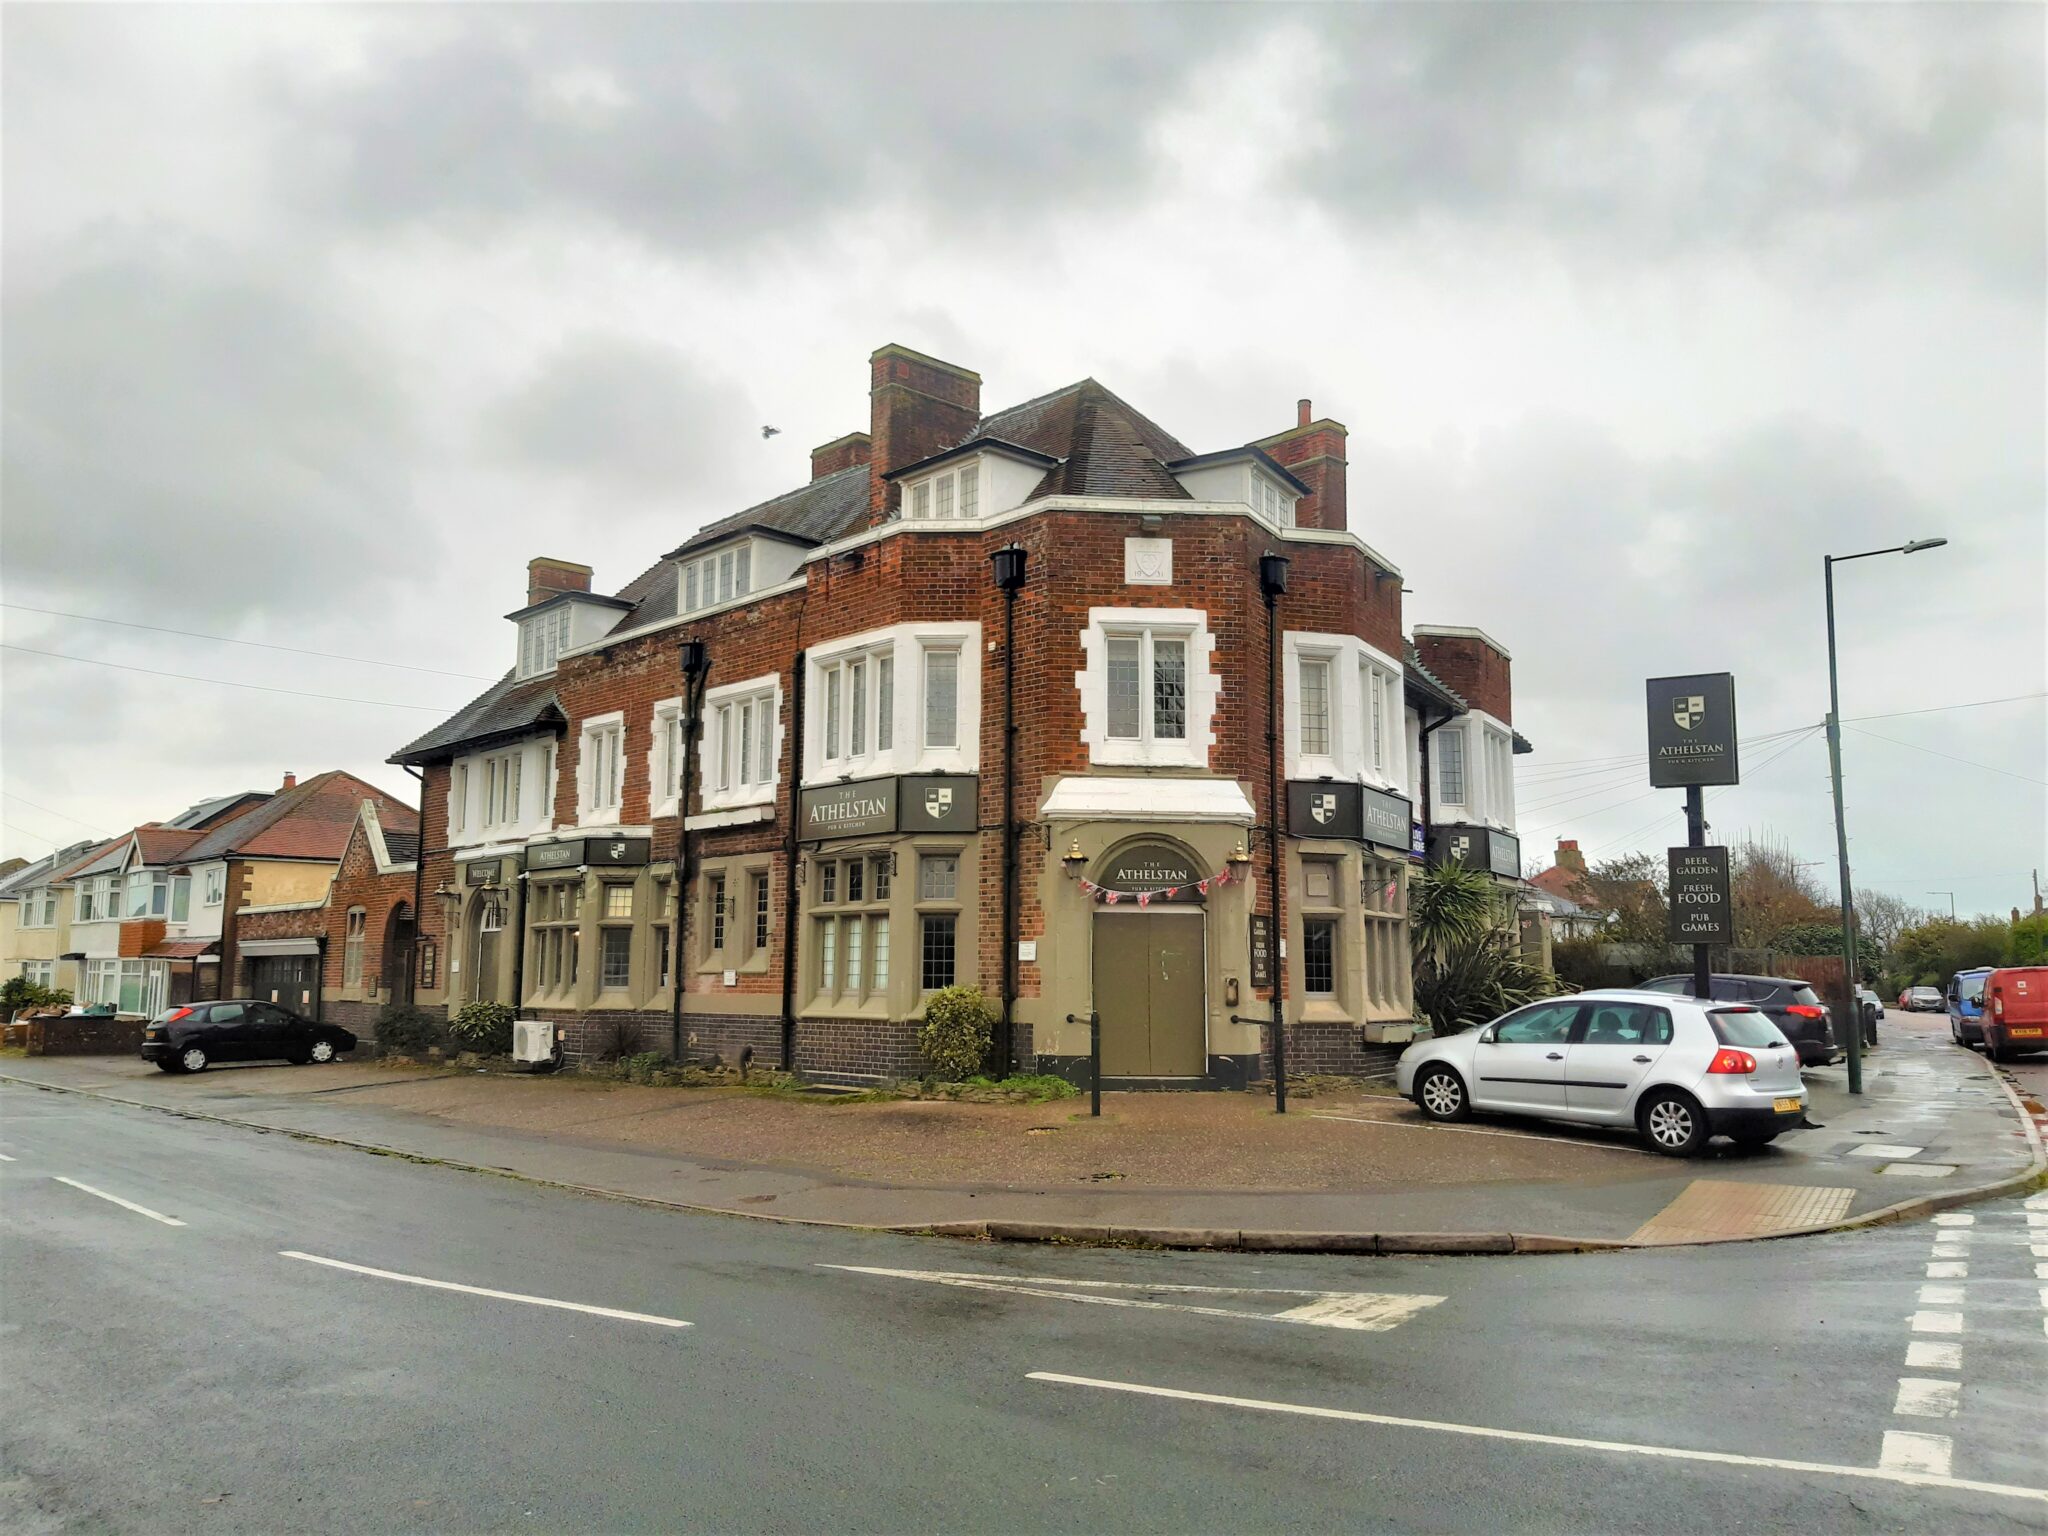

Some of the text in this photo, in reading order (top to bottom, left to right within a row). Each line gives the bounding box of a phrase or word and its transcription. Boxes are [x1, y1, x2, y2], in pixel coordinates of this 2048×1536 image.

[1658, 743, 1724, 756] ATHELSTAN
[839, 790, 856, 799] THE
[809, 797, 887, 822] ATHELSTAN
[1367, 804, 1407, 832] ATHELSTAN
[843, 821, 866, 829] KITCHEN
[540, 848, 571, 861] ATHELSTAN
[1685, 857, 1709, 865] BEER
[472, 868, 495, 878] WELCOME
[1116, 868, 1187, 880] ATHELSTAN
[1676, 866, 1718, 875] GARDEN
[1683, 884, 1713, 892] FRESH
[1677, 892, 1721, 904] FOOD
[1690, 913, 1710, 921] PUB
[1681, 922, 1720, 932] GAMES
[1253, 949, 1267, 958] FOOD
